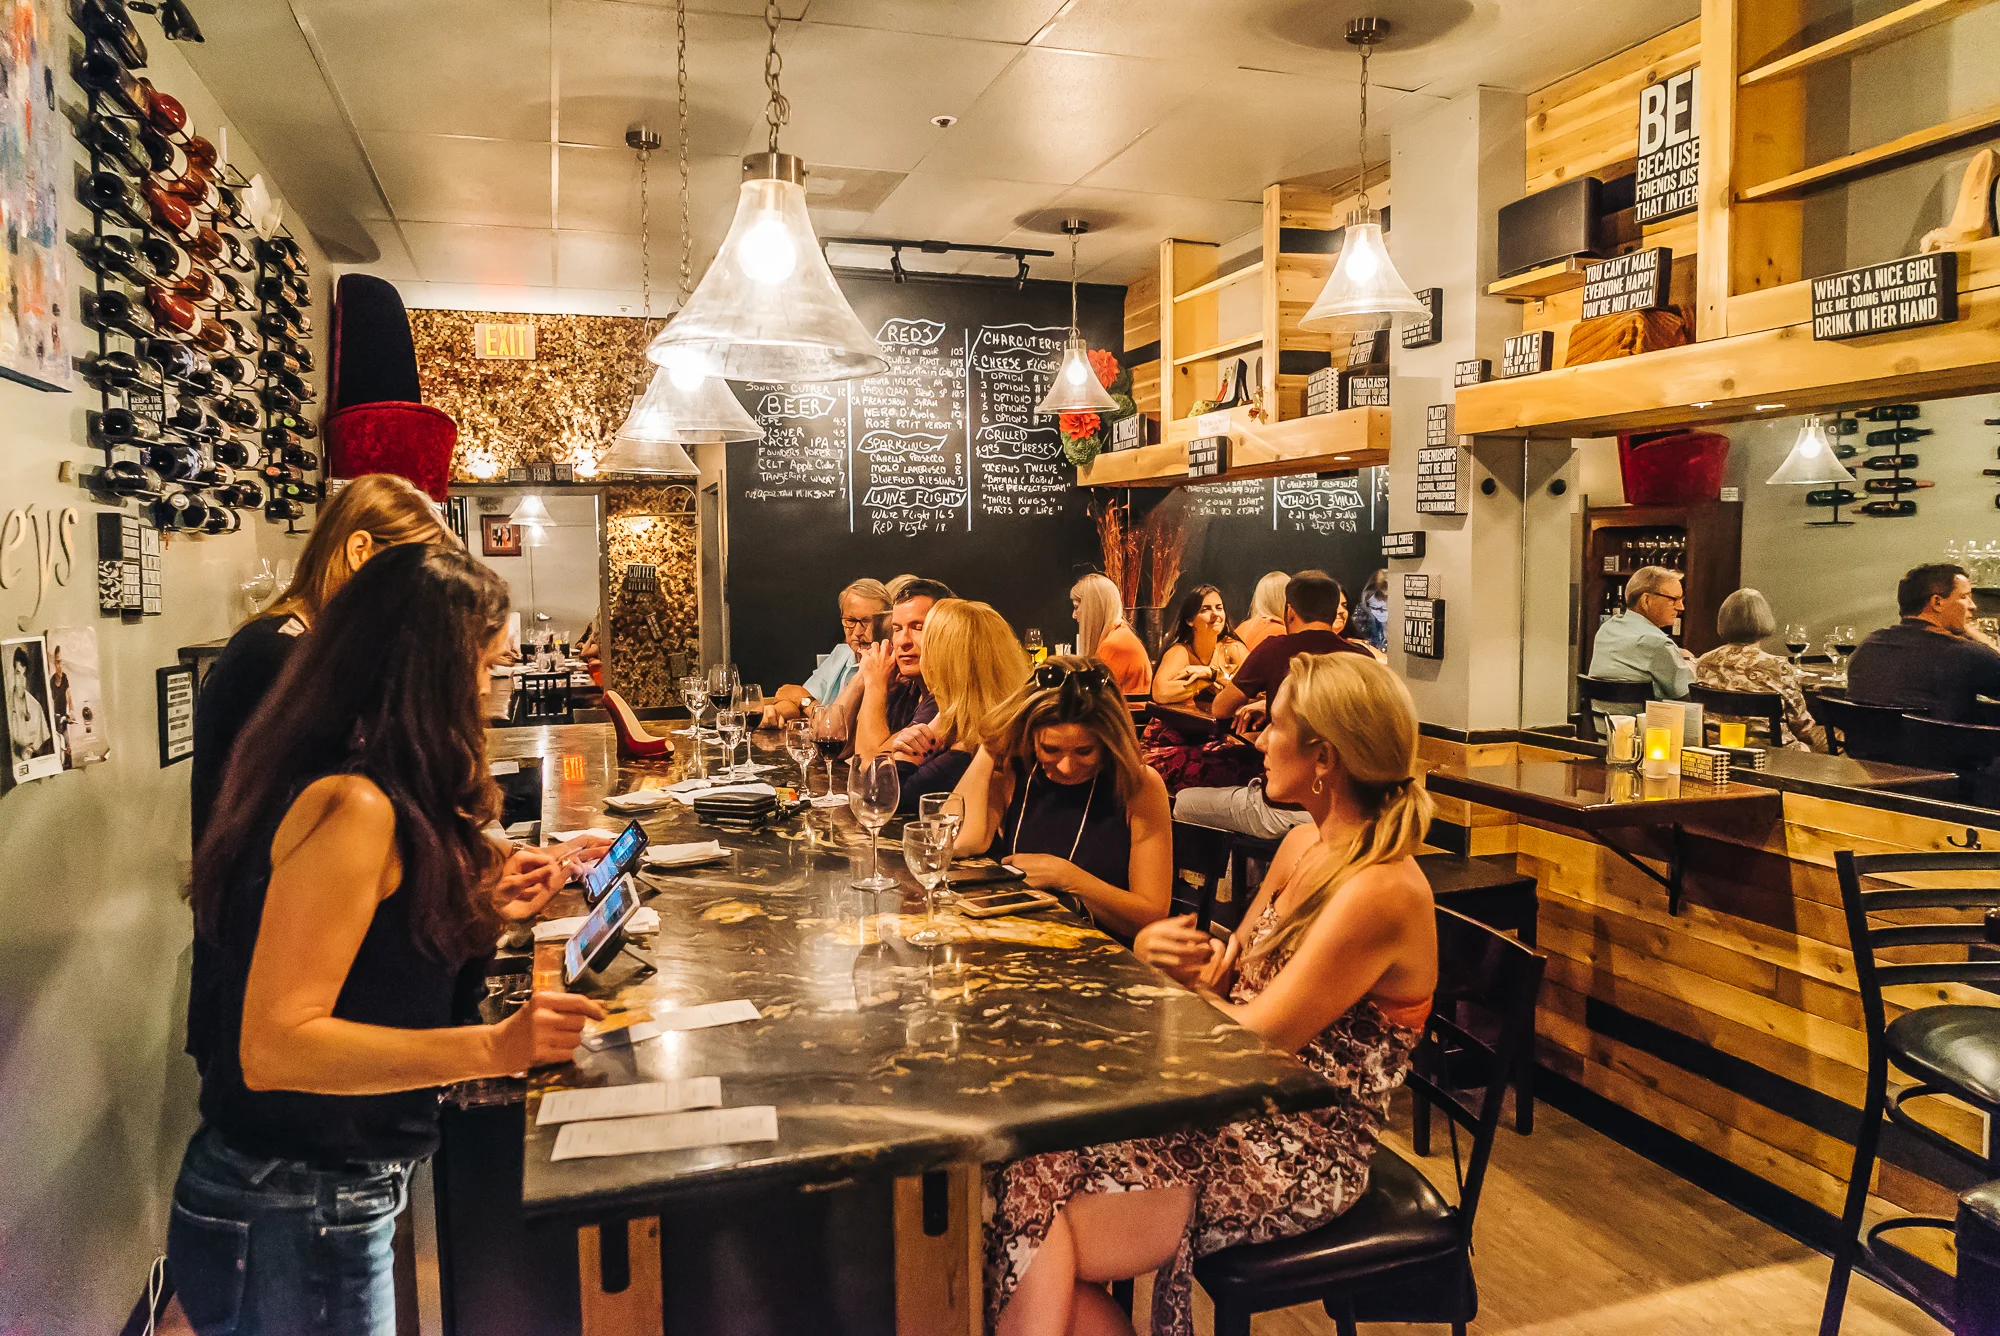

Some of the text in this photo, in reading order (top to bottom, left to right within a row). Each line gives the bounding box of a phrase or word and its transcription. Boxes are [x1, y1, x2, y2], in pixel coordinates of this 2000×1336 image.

[1638, 139, 1700, 182] BECAUSE
[1636, 173, 1677, 202] FRIENDS
[1635, 196, 1663, 221] THAT
[1586, 250, 1657, 283] YOU CAN'T MAKE
[1584, 269, 1656, 302] EVERYONE HAPPY
[1814, 258, 1937, 301] WHAT'S A NICE GIRL
[1583, 289, 1653, 319] YOU'RE NOT PIZZA
[1814, 281, 1937, 316] LIKE ME DOING WITHOUT A
[1815, 297, 1938, 338] DRINK IN HER HAND
[485, 325, 527, 356] EXIT
[887, 325, 933, 343] REDS
[982, 331, 1062, 351] CHARCUTERIE
[1505, 334, 1539, 358] WINE
[981, 354, 1021, 370] CHEESE
[1504, 352, 1538, 368] ME UP AND
[1503, 362, 1538, 376] TURN ME ON
[990, 372, 1023, 382] OPTION
[1352, 377, 1388, 389] YOGA CLASS?
[790, 384, 830, 395] CUTRER
[980, 381, 1031, 392] 3 OPTIONS
[980, 392, 1031, 404] 4 OPTIONS
[1353, 395, 1372, 406] POUR A
[767, 396, 821, 415] BEER
[982, 402, 1027, 412] 5 OPTIONS
[863, 408, 896, 417] NERO
[951, 410, 961, 419] 10
[981, 414, 989, 423] 6
[995, 414, 1028, 423] OPTIONS
[754, 415, 782, 426] HEFE
[985, 427, 1027, 440] GRILLED
[810, 437, 829, 448] IPA
[838, 450, 844, 459] 7
[1012, 443, 1056, 456] CHEESES
[1419, 448, 1456, 463] FRIENDSHIPS
[954, 453, 962, 465] 8
[758, 459, 784, 470] CELT
[790, 460, 813, 473] Apple
[870, 464, 962, 475] MOLO 8
[1418, 461, 1456, 475] MUST BE BUILT
[839, 472, 845, 484] 7
[918, 476, 956, 485] RIESLING
[957, 476, 964, 487] 7
[840, 487, 846, 498] 7
[870, 490, 961, 506] WINE FLIGHTS
[1019, 506, 1030, 515] OF
[872, 520, 893, 535] RED
[1398, 533, 1414, 545] COFFEE
[629, 565, 655, 578] COFFEE
[1405, 620, 1432, 638] WINE
[1404, 635, 1431, 647] ME UP AND
